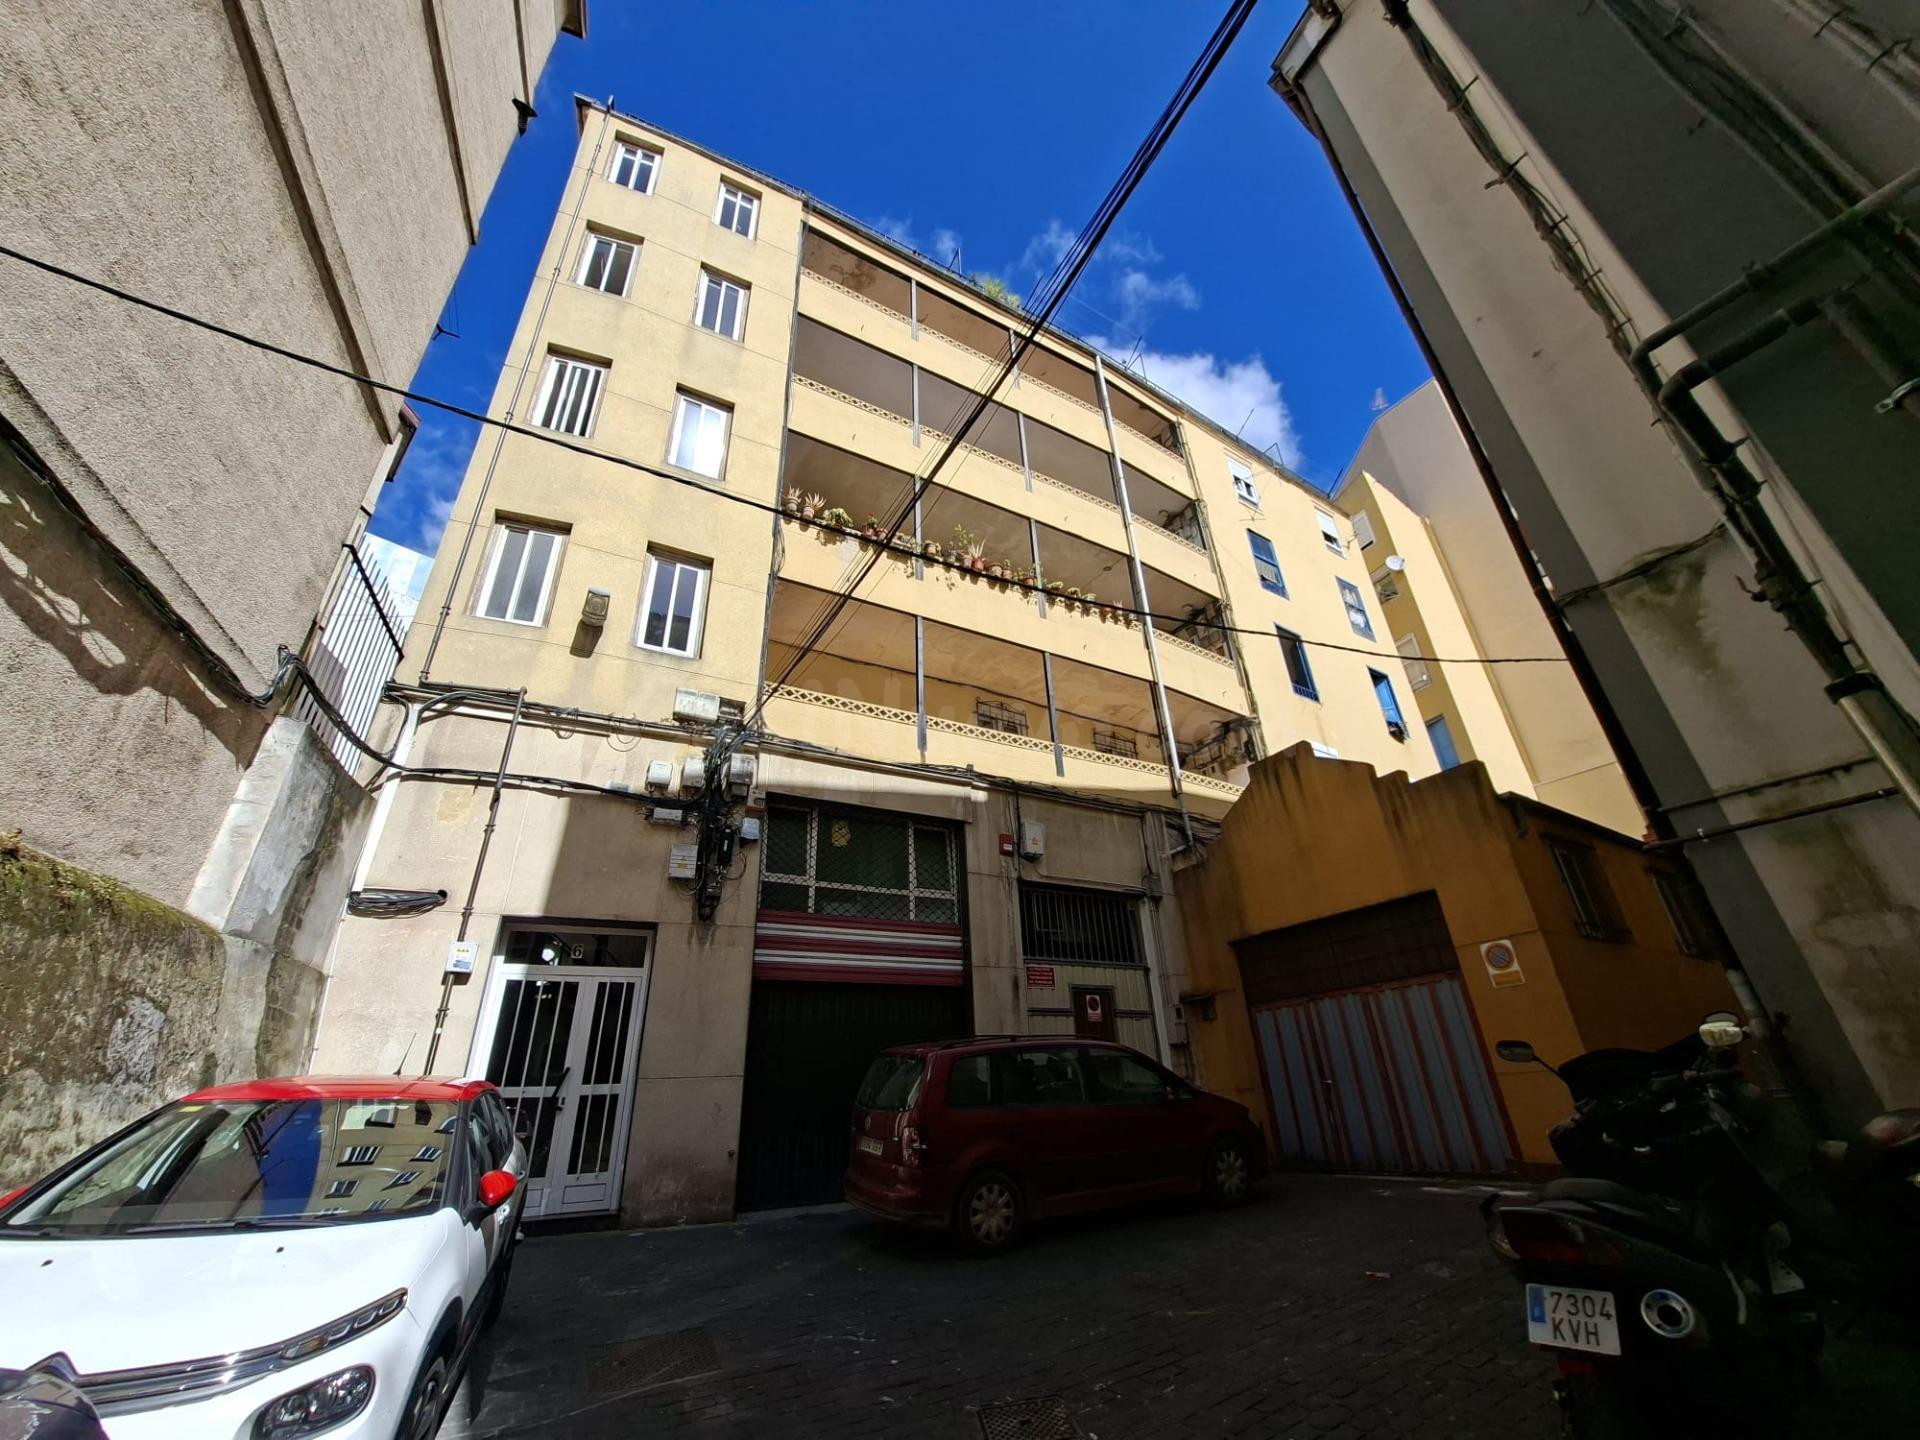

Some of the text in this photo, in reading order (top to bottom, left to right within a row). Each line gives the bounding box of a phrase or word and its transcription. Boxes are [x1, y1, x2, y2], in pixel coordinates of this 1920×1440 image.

[573, 945, 583, 957] 6
[1550, 1291, 1613, 1321] 7304
[1552, 1316, 1600, 1346] KVH
